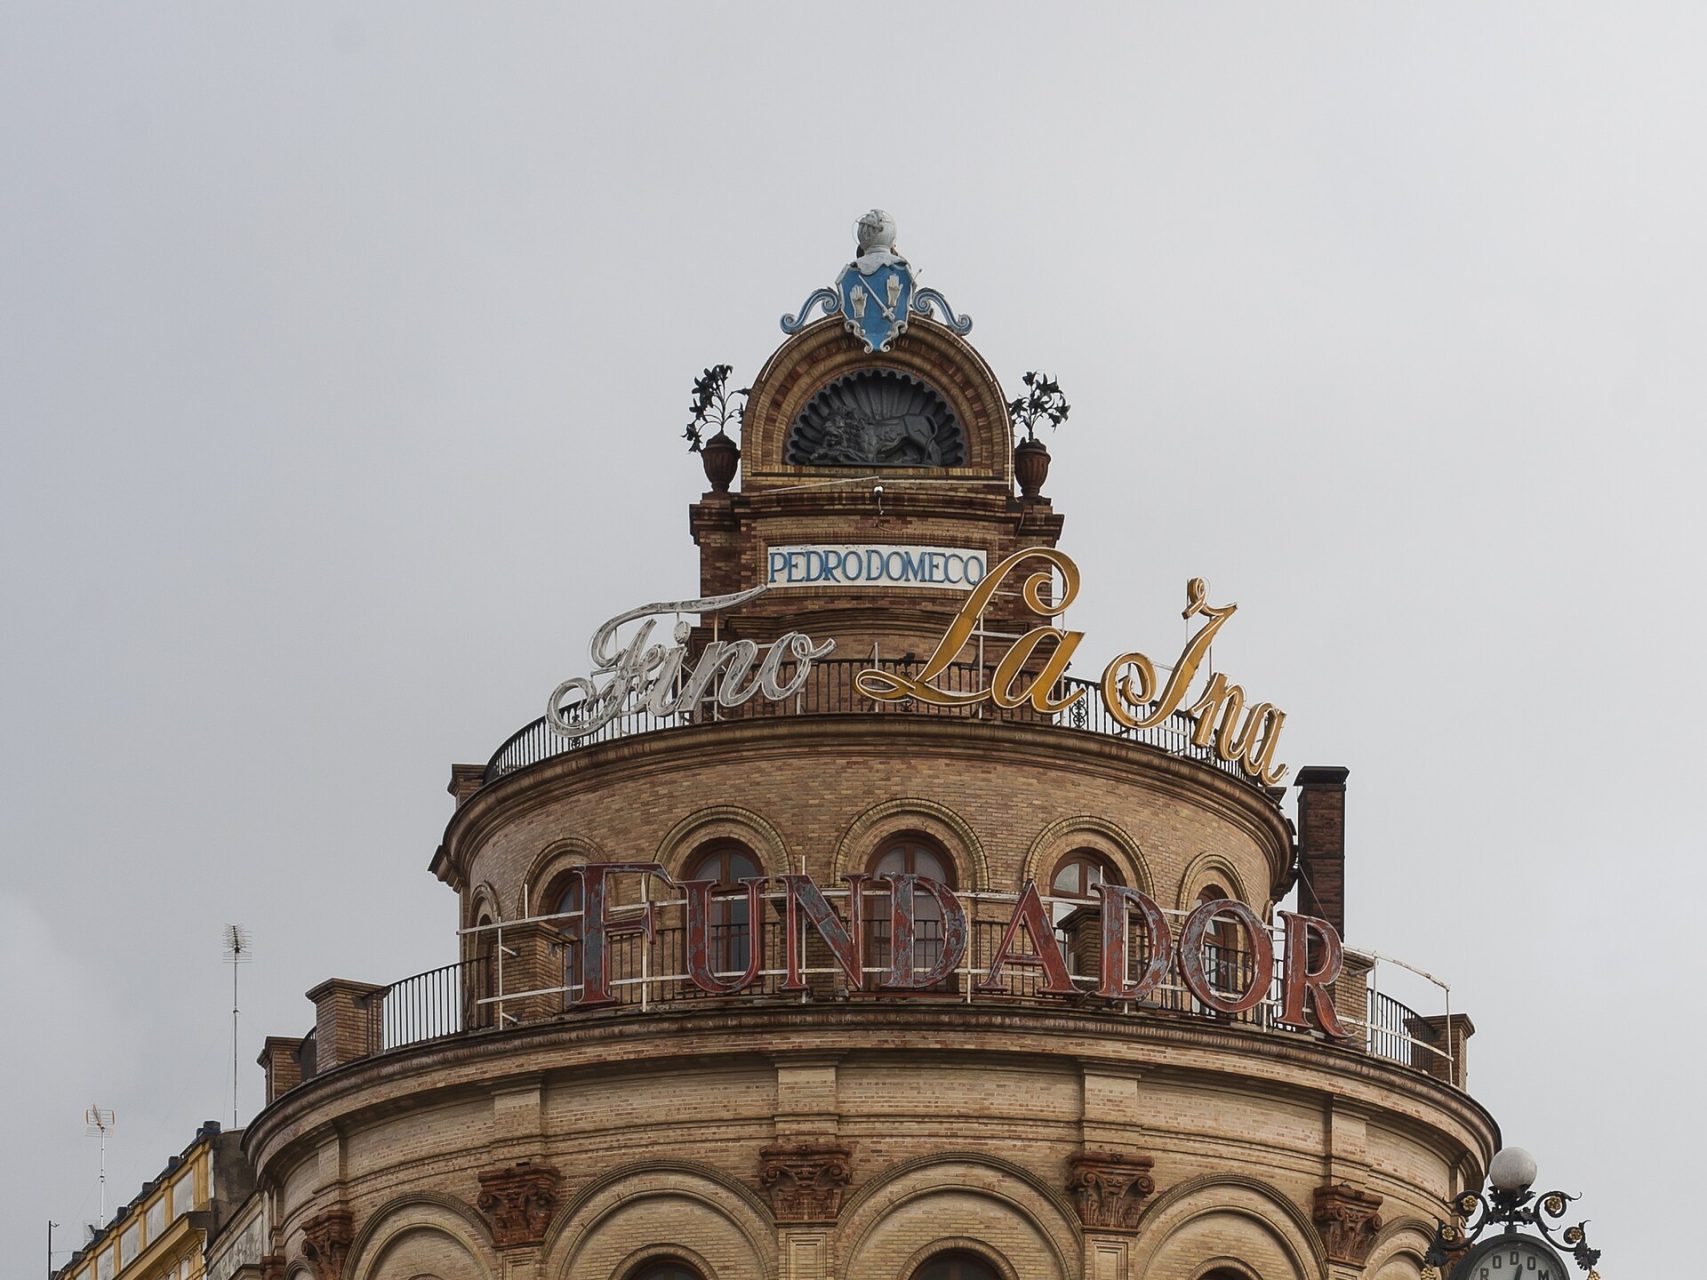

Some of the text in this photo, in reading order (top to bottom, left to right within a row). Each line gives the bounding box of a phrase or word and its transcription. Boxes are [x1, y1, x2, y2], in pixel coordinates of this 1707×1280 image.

[768, 550, 864, 583] PEDRO
[546, 583, 837, 738] Fino
[854, 546, 1290, 786] La Ina
[571, 862, 1359, 1041] FUNDADOR
